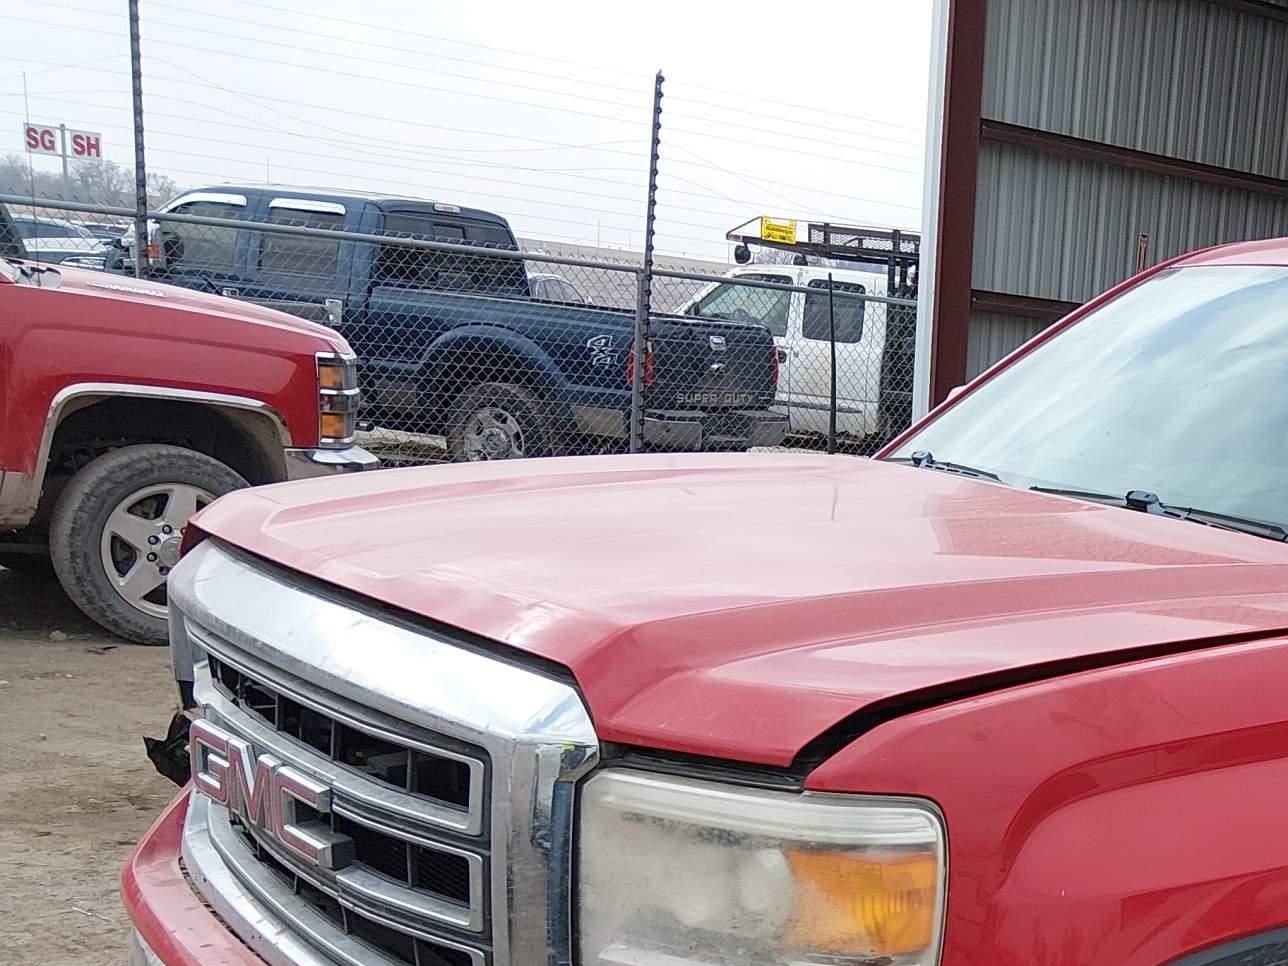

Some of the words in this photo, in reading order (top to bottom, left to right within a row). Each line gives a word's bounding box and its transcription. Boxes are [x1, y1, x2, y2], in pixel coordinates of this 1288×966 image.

[72, 134, 100, 158] SH
[677, 392, 718, 404] SUPER
[724, 393, 752, 404] DUTY
[189, 719, 333, 869] GMC
